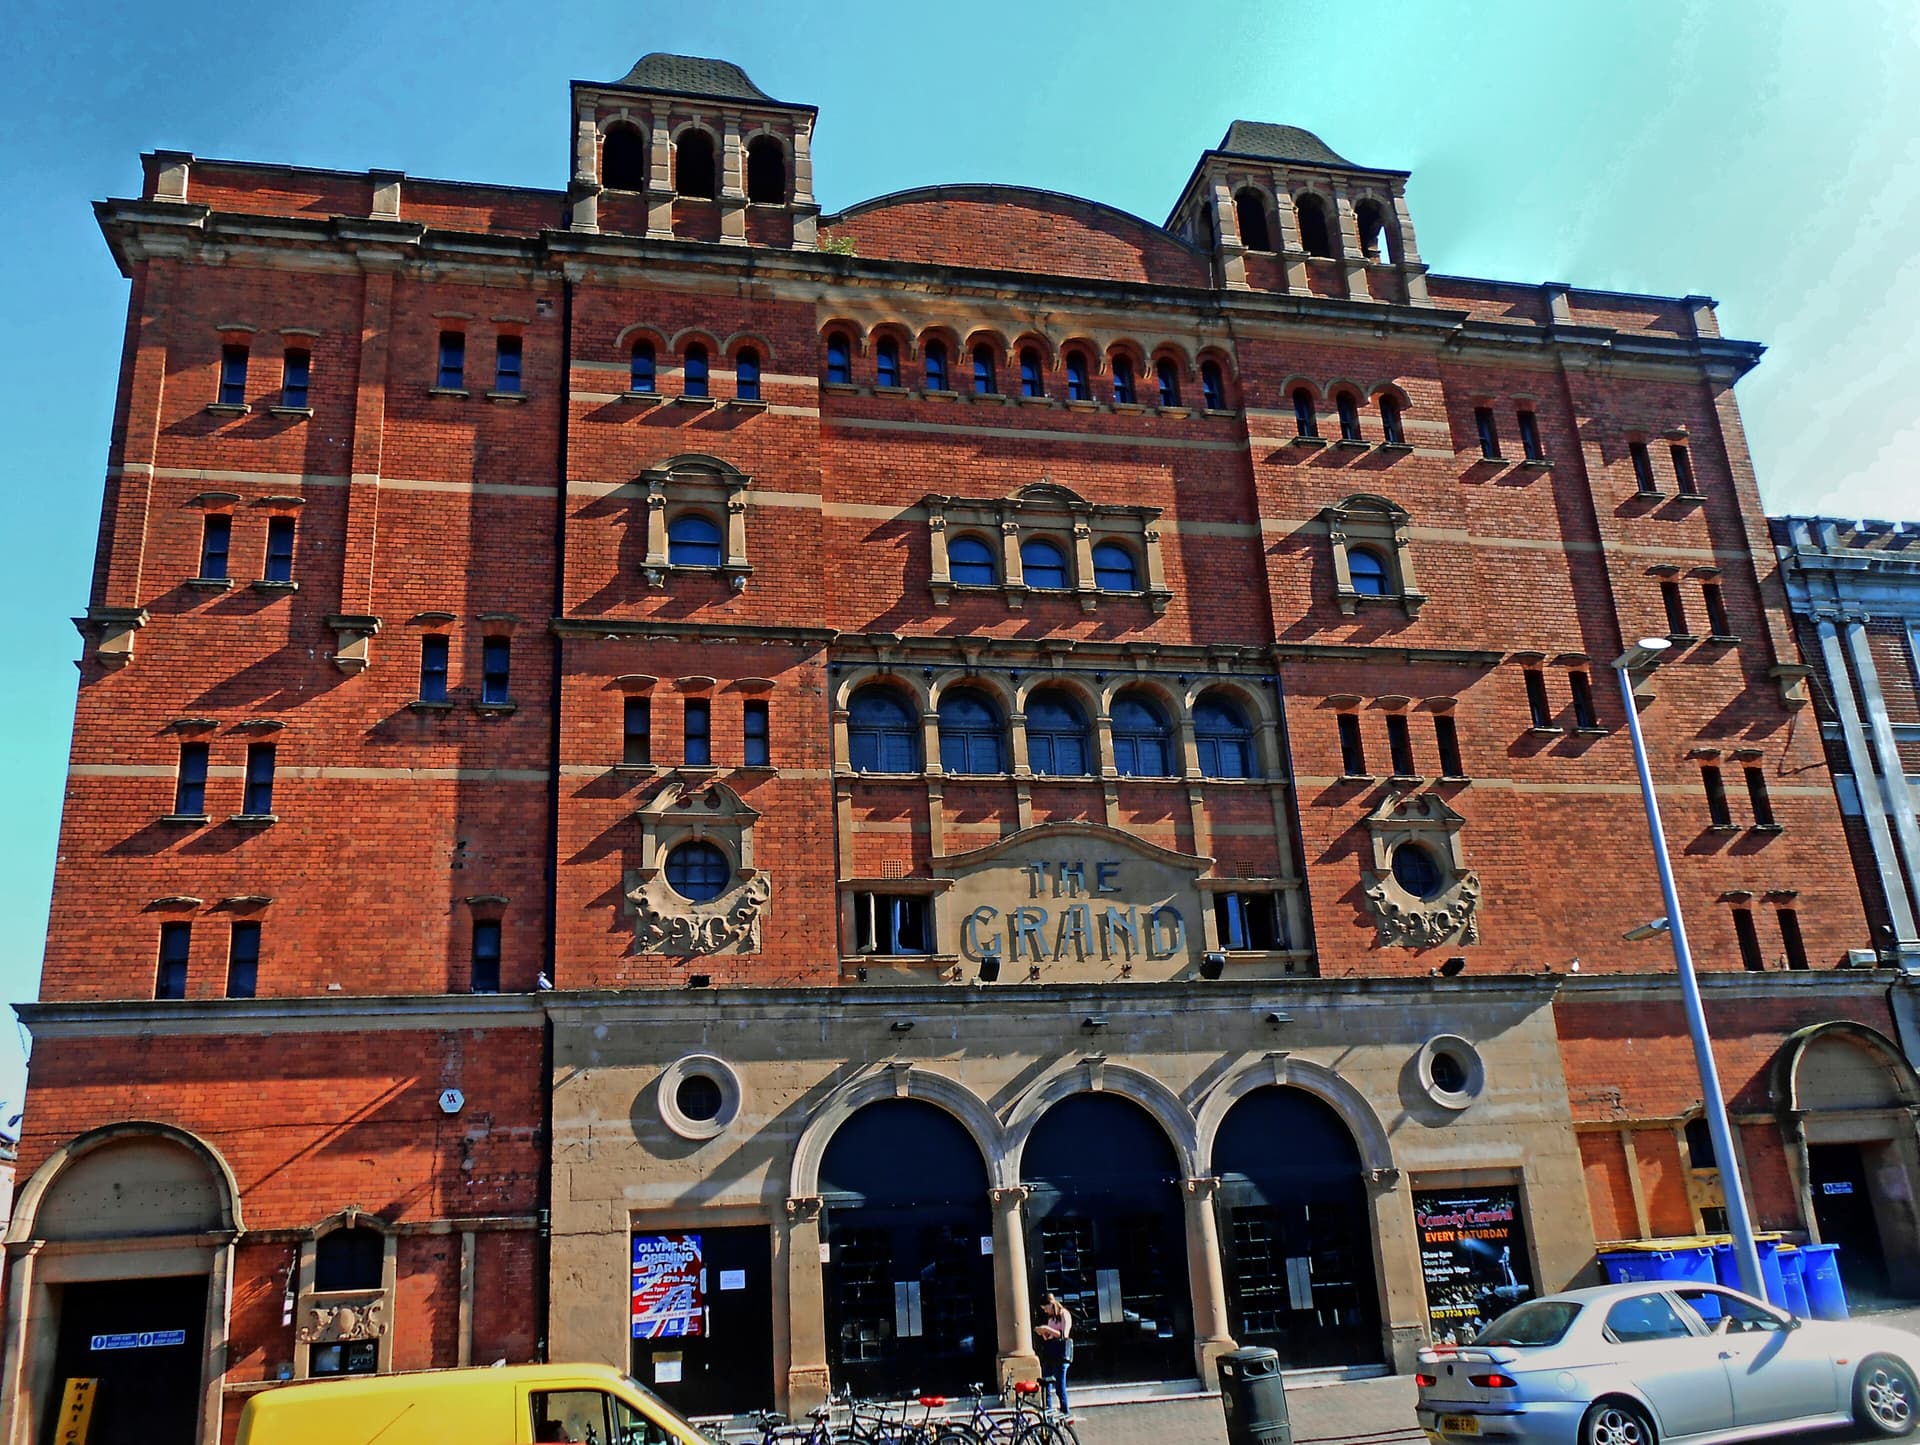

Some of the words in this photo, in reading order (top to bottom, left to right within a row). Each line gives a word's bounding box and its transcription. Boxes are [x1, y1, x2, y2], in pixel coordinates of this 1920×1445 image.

[1030, 861, 1122, 893] THE
[969, 903, 1187, 958] GRAND
[1417, 1210, 1465, 1229] Comedy
[1465, 1204, 1514, 1224] Carnival
[1425, 1231, 1455, 1243] EVERY
[1457, 1228, 1509, 1240] SATURDAY
[638, 1241, 697, 1253] OLYMPICS
[641, 1252, 694, 1263] OPENING
[648, 1262, 687, 1274] PARTY
[1430, 1310, 1445, 1319] 020
[72, 1382, 90, 1423] MINI
